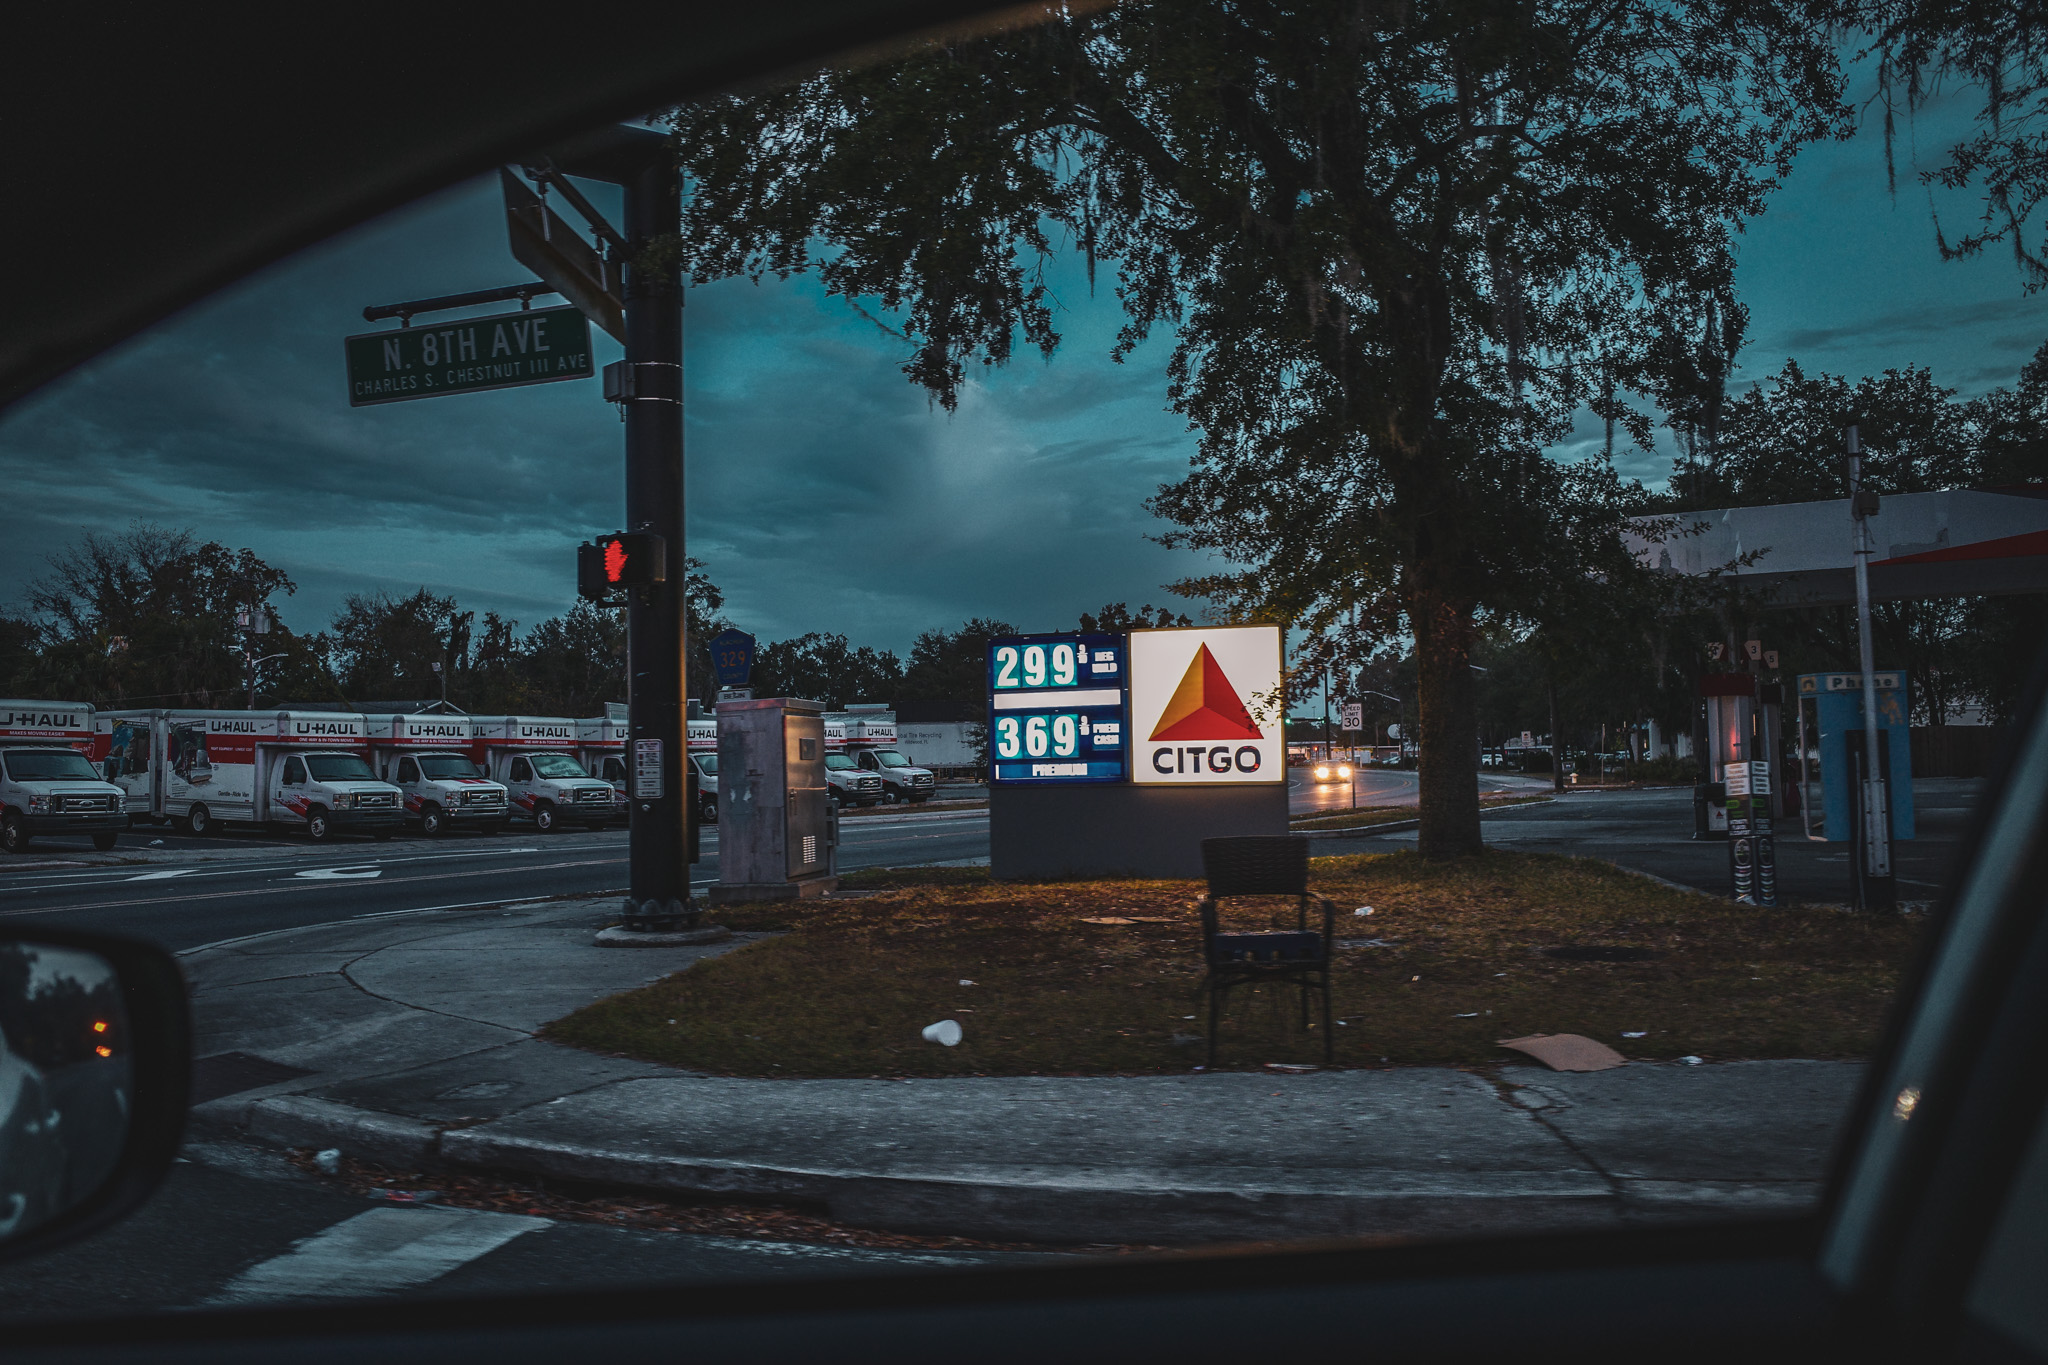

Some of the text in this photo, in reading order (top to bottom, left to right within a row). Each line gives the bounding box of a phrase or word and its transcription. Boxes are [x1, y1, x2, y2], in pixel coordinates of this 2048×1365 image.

[383, 318, 550, 372] N. 8TH AVE
[355, 353, 587, 396] CHARLES S. CHESTNUT III AVE
[1751, 645, 1757, 654] 3
[720, 650, 746, 668] 329
[1769, 655, 1775, 663] 5
[996, 644, 1075, 687] 299
[1833, 676, 1892, 689] Phne
[723, 692, 746, 700] BEGIN
[211, 721, 256, 733] U-HAUL
[1344, 717, 1360, 727] 30
[297, 723, 357, 735] U-HAUL
[410, 725, 464, 736] U-HAUL
[522, 726, 571, 738] U-HAUL
[687, 729, 718, 739] U-HAU
[824, 728, 843, 738] HAUL
[867, 728, 894, 737] U-HAUL
[998, 715, 1075, 758] 369
[1152, 746, 1261, 774] CITGO
